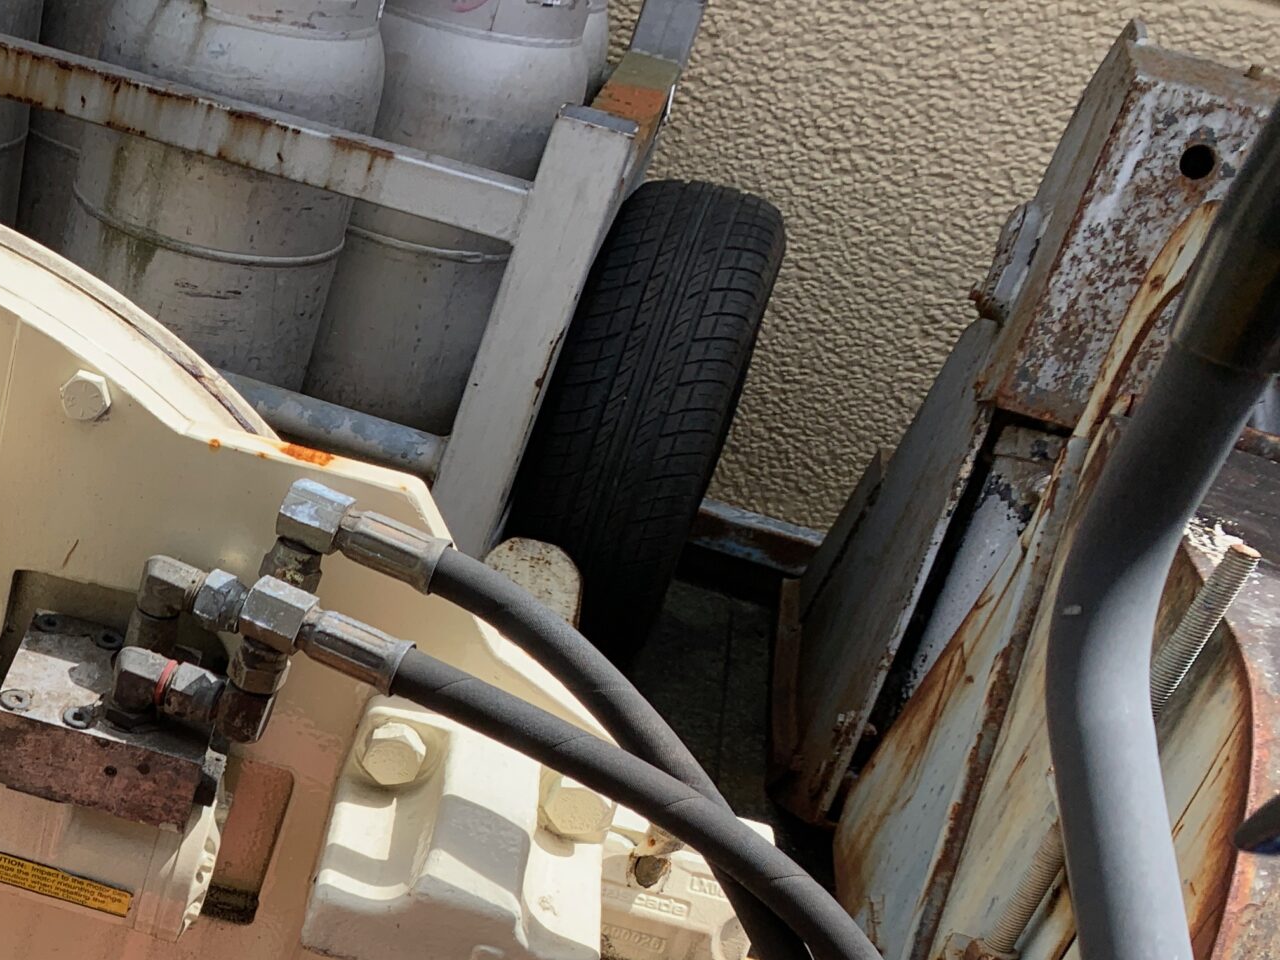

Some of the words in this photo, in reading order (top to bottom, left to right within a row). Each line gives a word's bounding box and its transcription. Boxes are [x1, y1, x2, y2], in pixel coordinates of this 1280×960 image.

[30, 879, 52, 888] when
[31, 865, 58, 878] Impact
[86, 883, 109, 893] motor
[31, 873, 55, 884] motor
[57, 880, 94, 895] mounting
